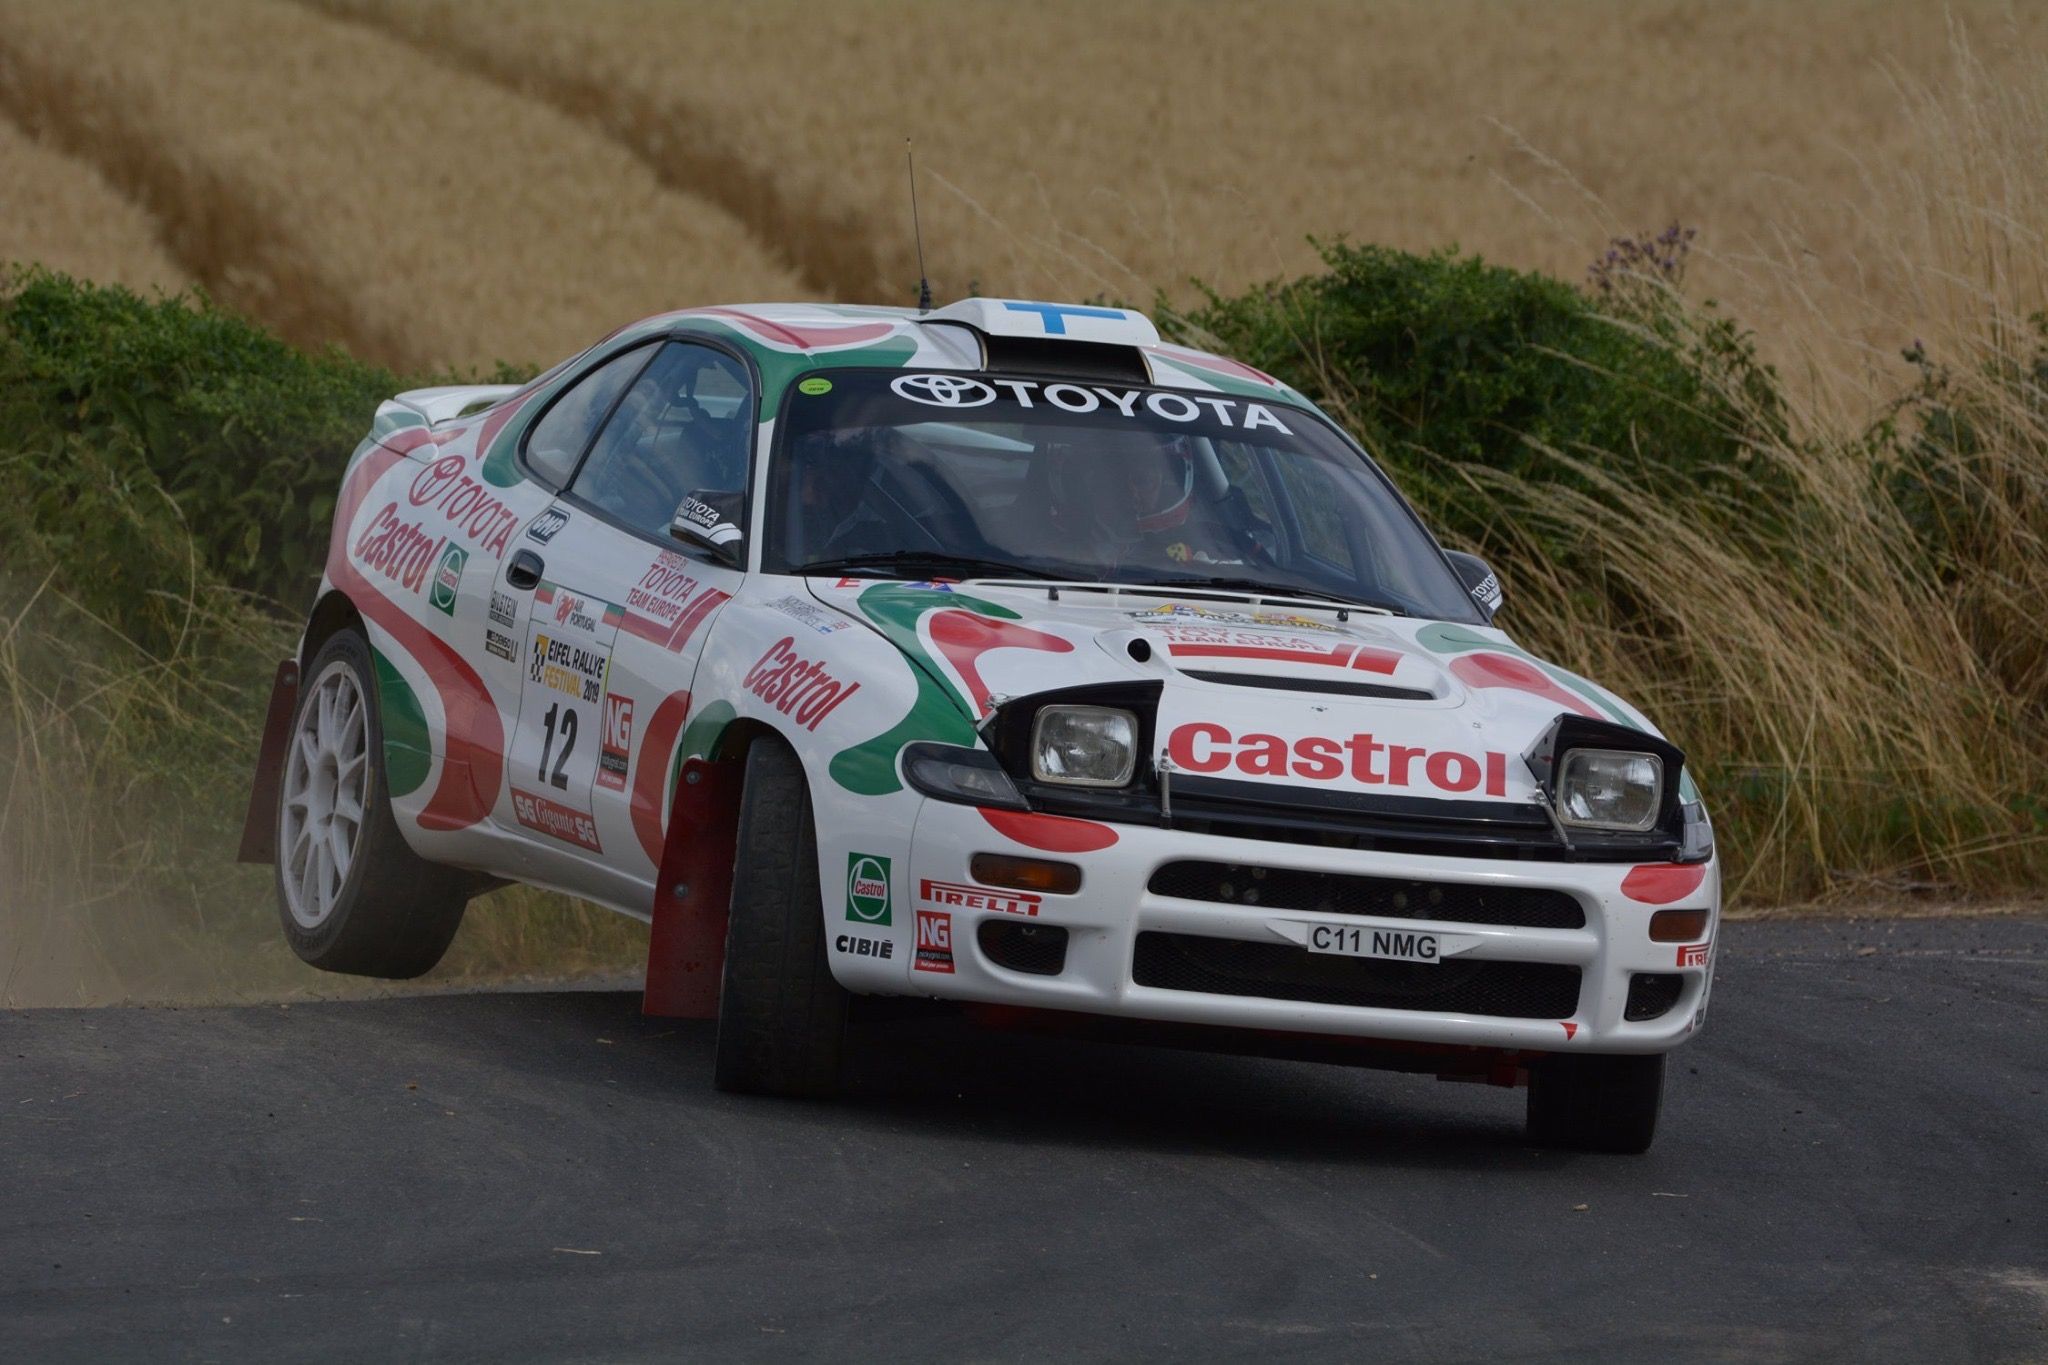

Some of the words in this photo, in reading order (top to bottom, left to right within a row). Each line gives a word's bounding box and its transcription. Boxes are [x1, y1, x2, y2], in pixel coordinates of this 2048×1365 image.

[993, 378, 1294, 436] TOYOTA
[437, 476, 519, 560] TOYOTA
[354, 502, 447, 594] Castrol
[638, 563, 699, 603] TOYOTA
[626, 588, 651, 609] TEAM
[646, 596, 681, 621] EUROPE
[1162, 626, 1316, 646] TOYOTA
[1164, 635, 1229, 644] TEAM
[1236, 638, 1328, 652] EUROPE
[548, 639, 571, 667] EIFEL
[572, 648, 605, 679] RALLYE
[543, 664, 581, 698] FESTIVAL
[583, 679, 600, 704] 2019
[742, 635, 861, 732] Castrol
[605, 698, 631, 751] NG
[538, 702, 578, 791] 12
[1168, 722, 1507, 797] Castrol
[515, 795, 537, 824] SG
[575, 817, 597, 845] SG
[855, 879, 886, 898] Castrol
[920, 878, 1043, 917] PIRELLI
[836, 934, 893, 960] CIBIÉ
[920, 916, 949, 948] NG
[1312, 926, 1361, 953] C11
[1372, 931, 1437, 959] NMG
